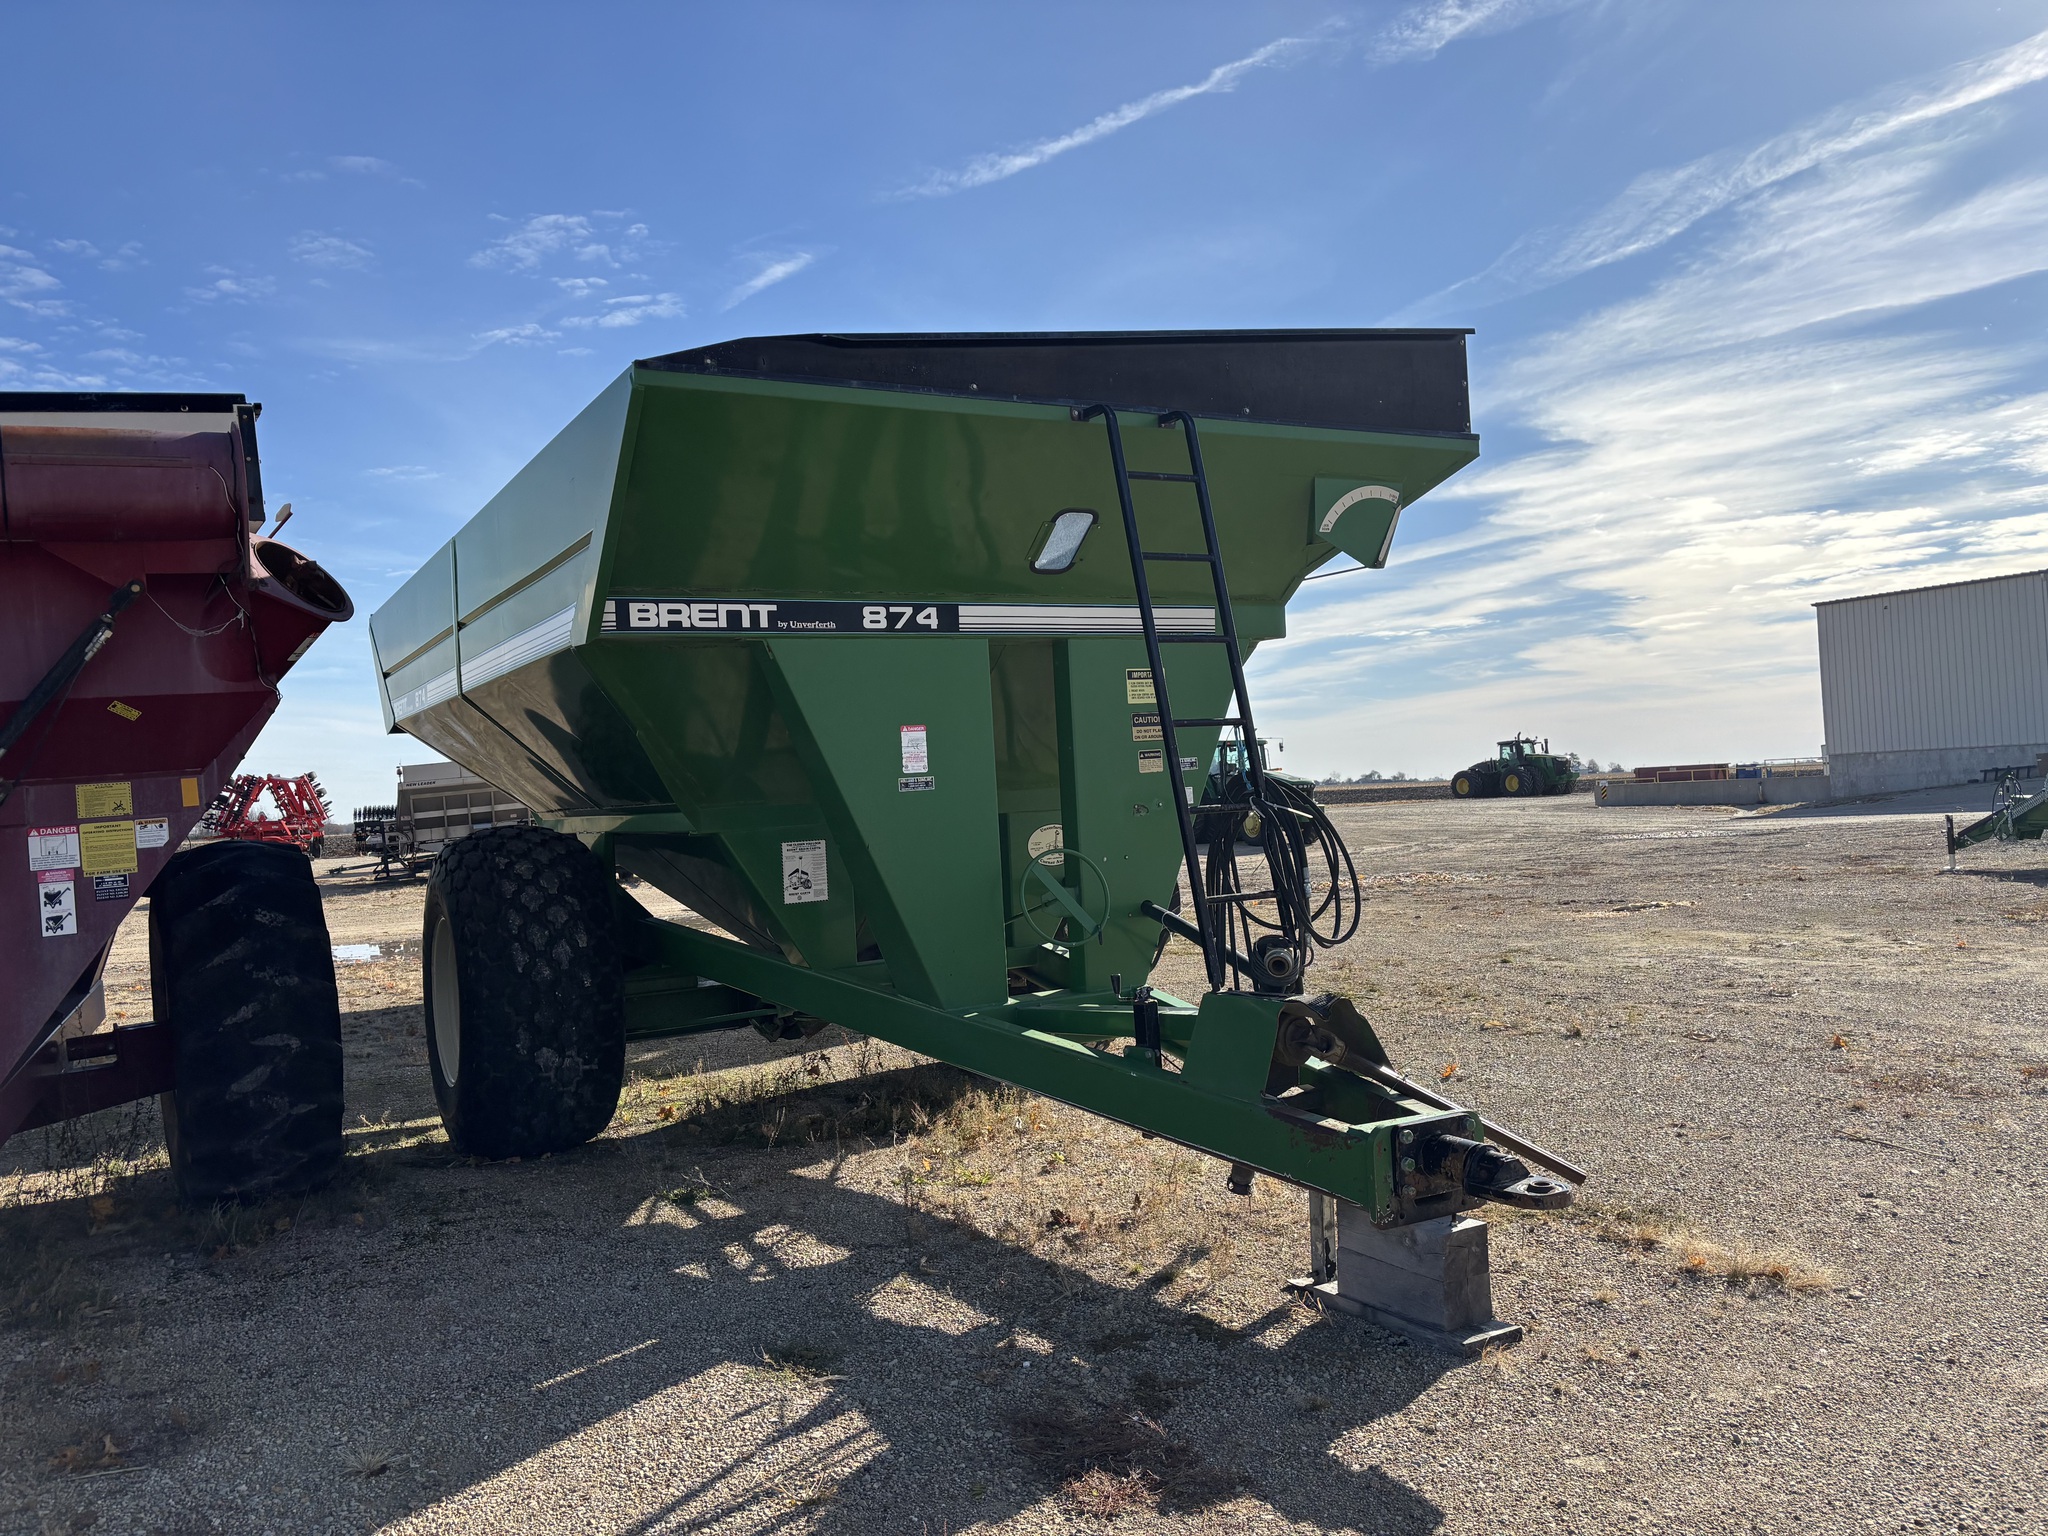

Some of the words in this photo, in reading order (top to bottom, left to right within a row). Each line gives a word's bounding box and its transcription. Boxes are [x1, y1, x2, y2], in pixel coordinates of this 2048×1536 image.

[628, 602, 777, 628] BRENT
[777, 620, 788, 632] by
[789, 620, 836, 630] Unverferth
[862, 606, 939, 630] 874
[1131, 671, 1153, 679] IMPORTA
[40, 826, 77, 835] DANGER
